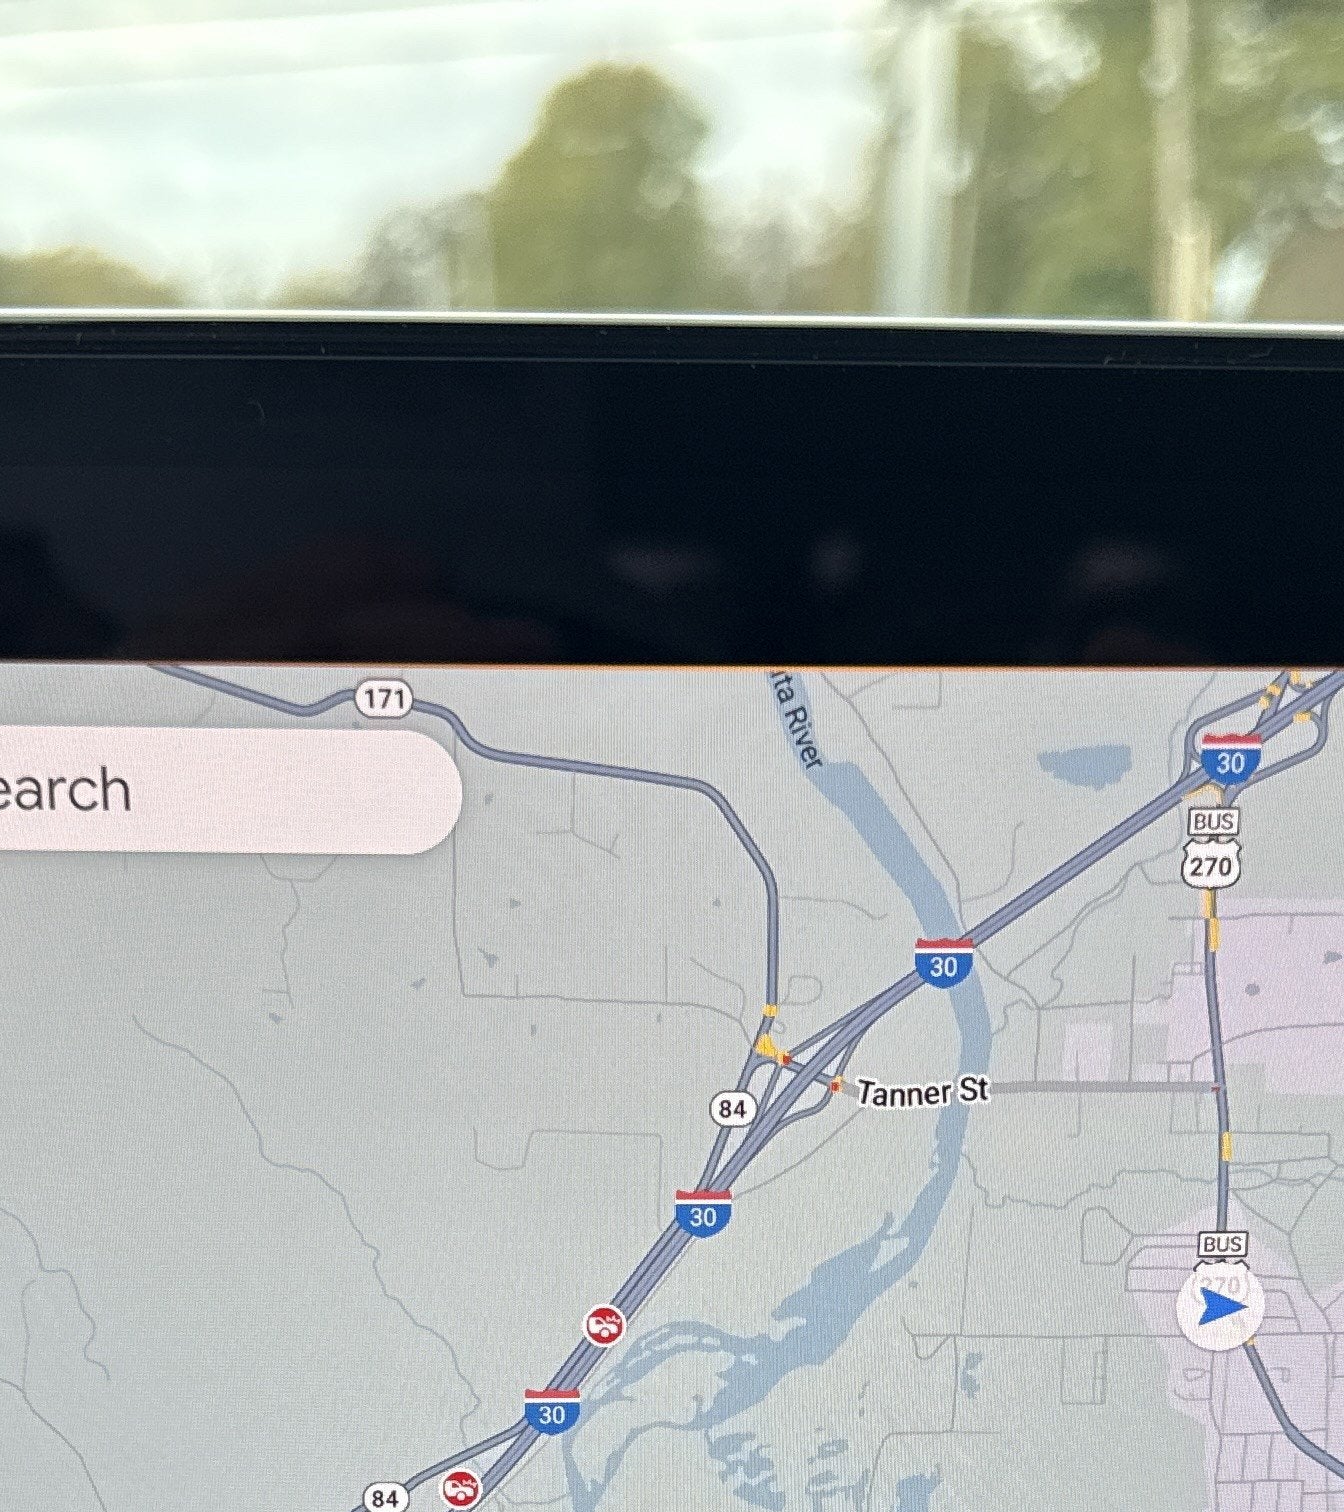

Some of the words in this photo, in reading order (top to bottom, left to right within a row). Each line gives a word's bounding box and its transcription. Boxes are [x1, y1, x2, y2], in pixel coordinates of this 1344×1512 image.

[364, 687, 406, 710] 171
[785, 705, 824, 770] River
[1216, 752, 1245, 774] 30
[1193, 812, 1234, 832] BUS
[1189, 857, 1233, 877] 270
[929, 956, 958, 978] 30
[858, 1079, 953, 1107] Tanner
[959, 1076, 989, 1103] St
[718, 1100, 747, 1119] 84
[689, 1206, 718, 1228] 30
[1203, 1235, 1242, 1253] BUS
[538, 1405, 566, 1425] 30
[372, 1490, 399, 1508] 84
